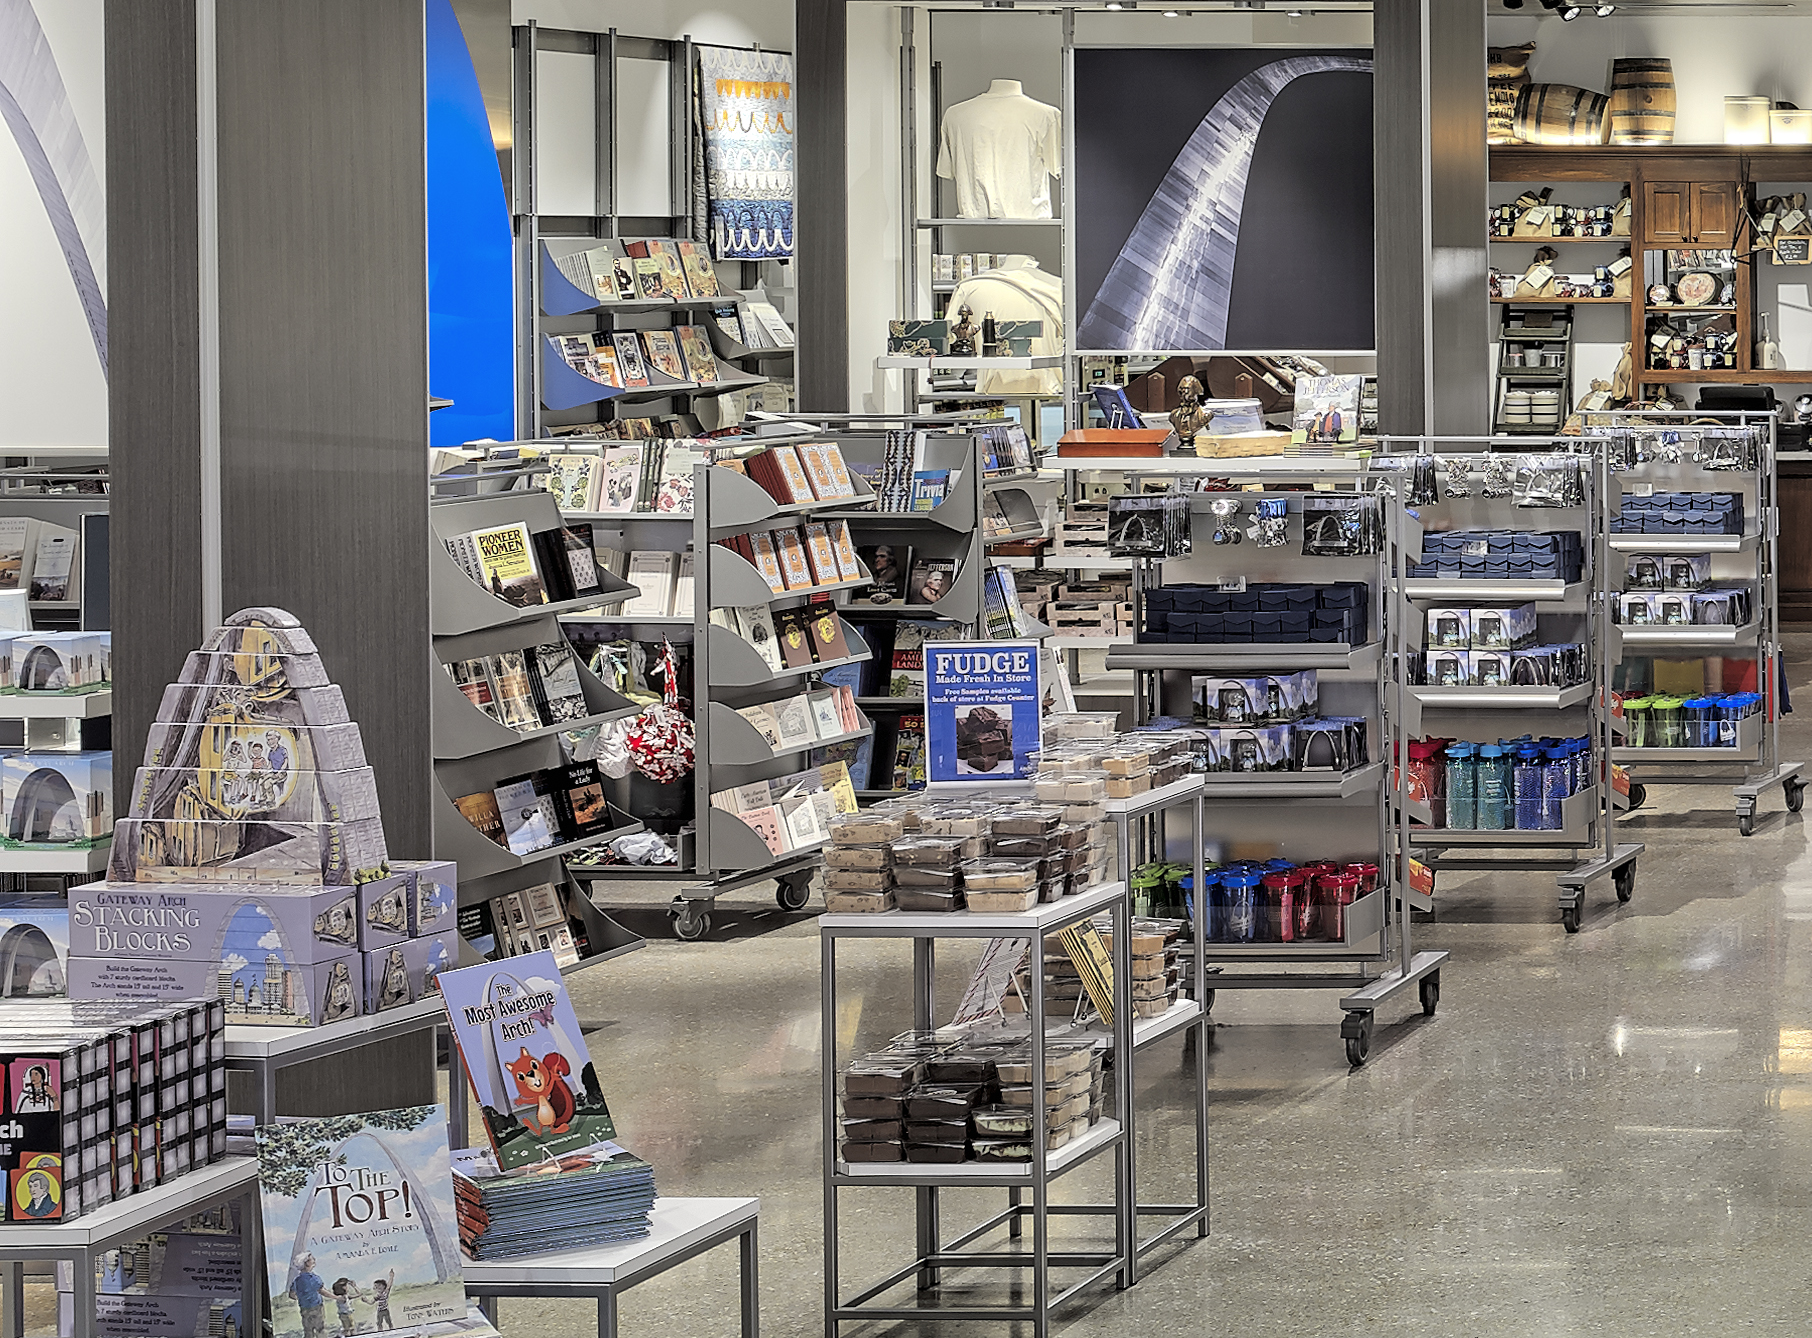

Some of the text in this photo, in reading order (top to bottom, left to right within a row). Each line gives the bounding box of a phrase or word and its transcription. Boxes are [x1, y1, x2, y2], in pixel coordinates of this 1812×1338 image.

[914, 478, 944, 498] Trivia
[478, 529, 521, 547] PIONEER
[480, 540, 524, 557] WOMEN
[935, 652, 1030, 675] FUDGE
[935, 673, 1031, 683] Made Fresh In Store
[97, 893, 186, 907] GATEWAY ARCH
[73, 899, 200, 928] STACKING
[94, 926, 191, 952] BLOCKS
[496, 983, 512, 997] The
[463, 991, 555, 1026] Most Awesome
[500, 1016, 535, 1042] Arch!
[317, 1161, 391, 1191] TO THE
[313, 1180, 413, 1229] TOP!
